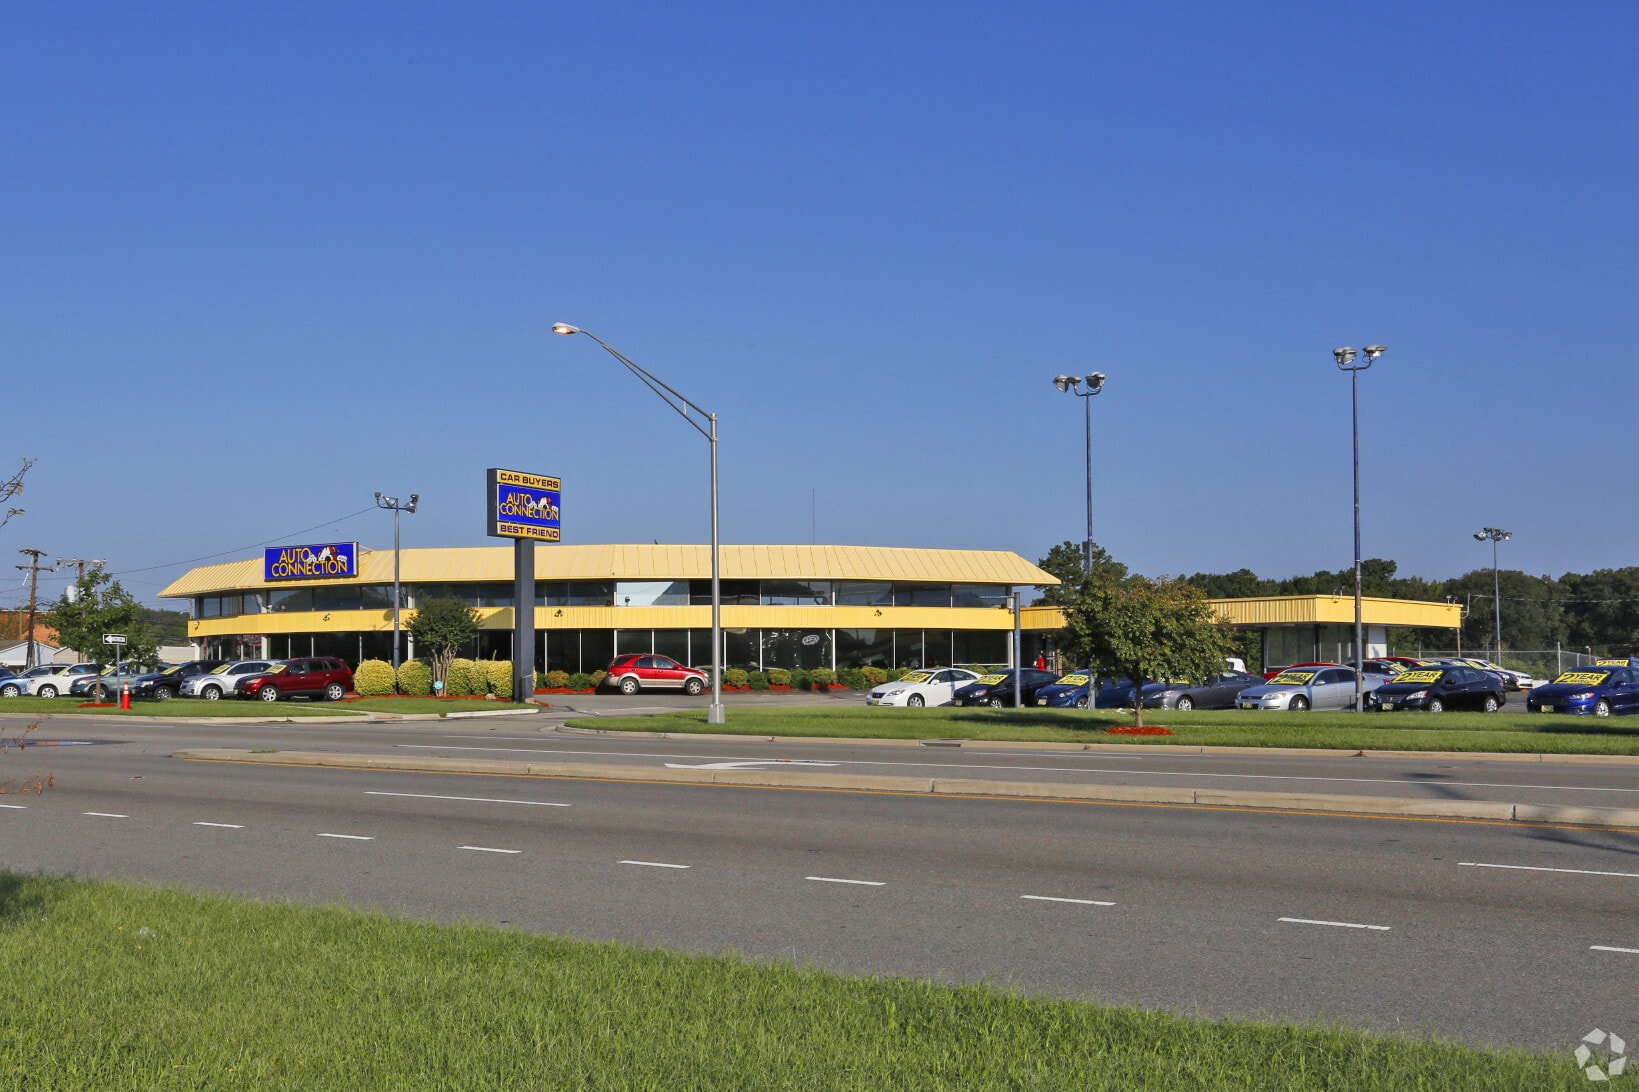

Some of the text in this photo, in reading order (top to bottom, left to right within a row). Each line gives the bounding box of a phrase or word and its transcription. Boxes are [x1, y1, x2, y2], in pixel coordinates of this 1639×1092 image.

[500, 473, 559, 488] CAR BUYERS
[506, 492, 532, 506] AUTO
[499, 503, 559, 521] CONNECTION
[500, 525, 558, 538] BEST FRIEND
[279, 547, 312, 563] AUTO
[271, 560, 348, 577] CONNECTION
[1558, 673, 1575, 683] 2
[1575, 673, 1601, 681] YEAR
